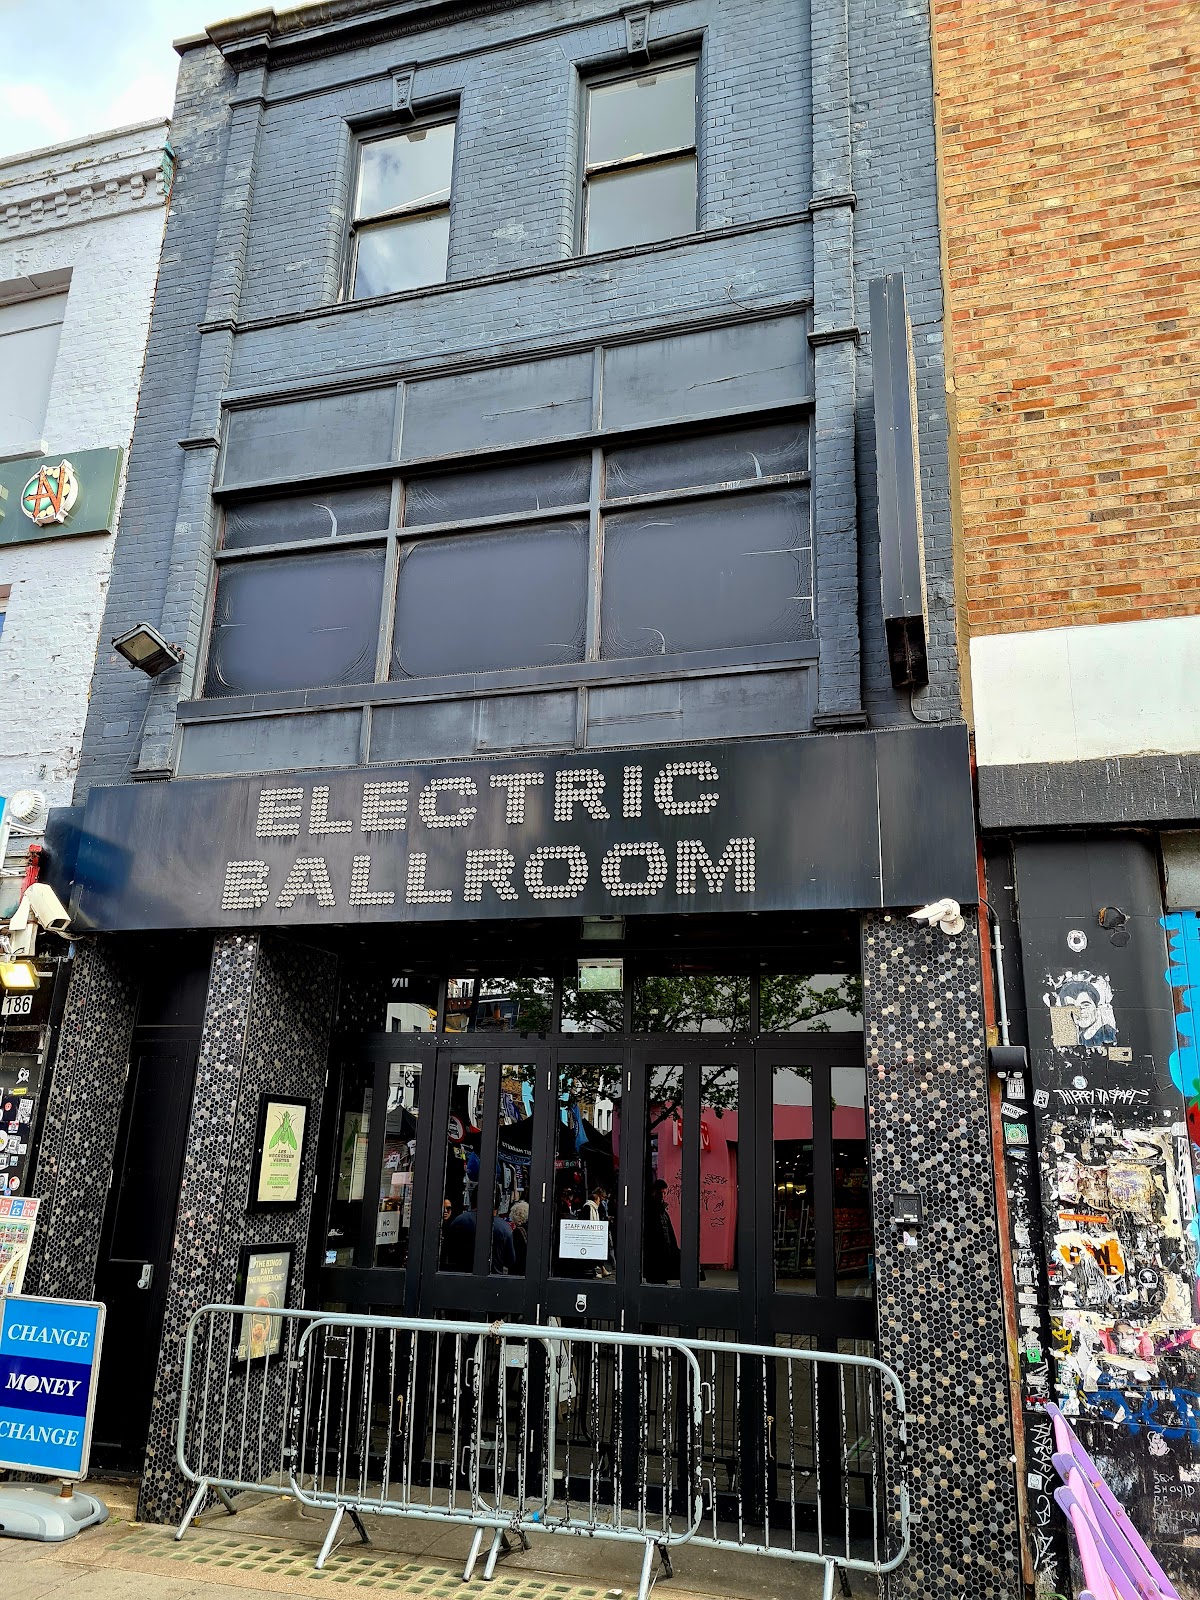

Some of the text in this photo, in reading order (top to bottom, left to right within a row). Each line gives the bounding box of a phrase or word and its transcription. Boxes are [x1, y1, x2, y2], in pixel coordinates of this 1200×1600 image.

[255, 760, 721, 838] ELECTRIC
[221, 836, 757, 911] BALLROOM
[6, 996, 31, 1013] 186
[12, 1208, 21, 1216] £5
[22, 1209, 35, 1217] £10
[256, 1258, 283, 1268] THE BINGO
[260, 1267, 274, 1275] RAVE
[7, 1323, 91, 1348] CHANGE
[5, 1372, 82, 1397] MONEY
[0, 1420, 79, 1447] CHANGE
